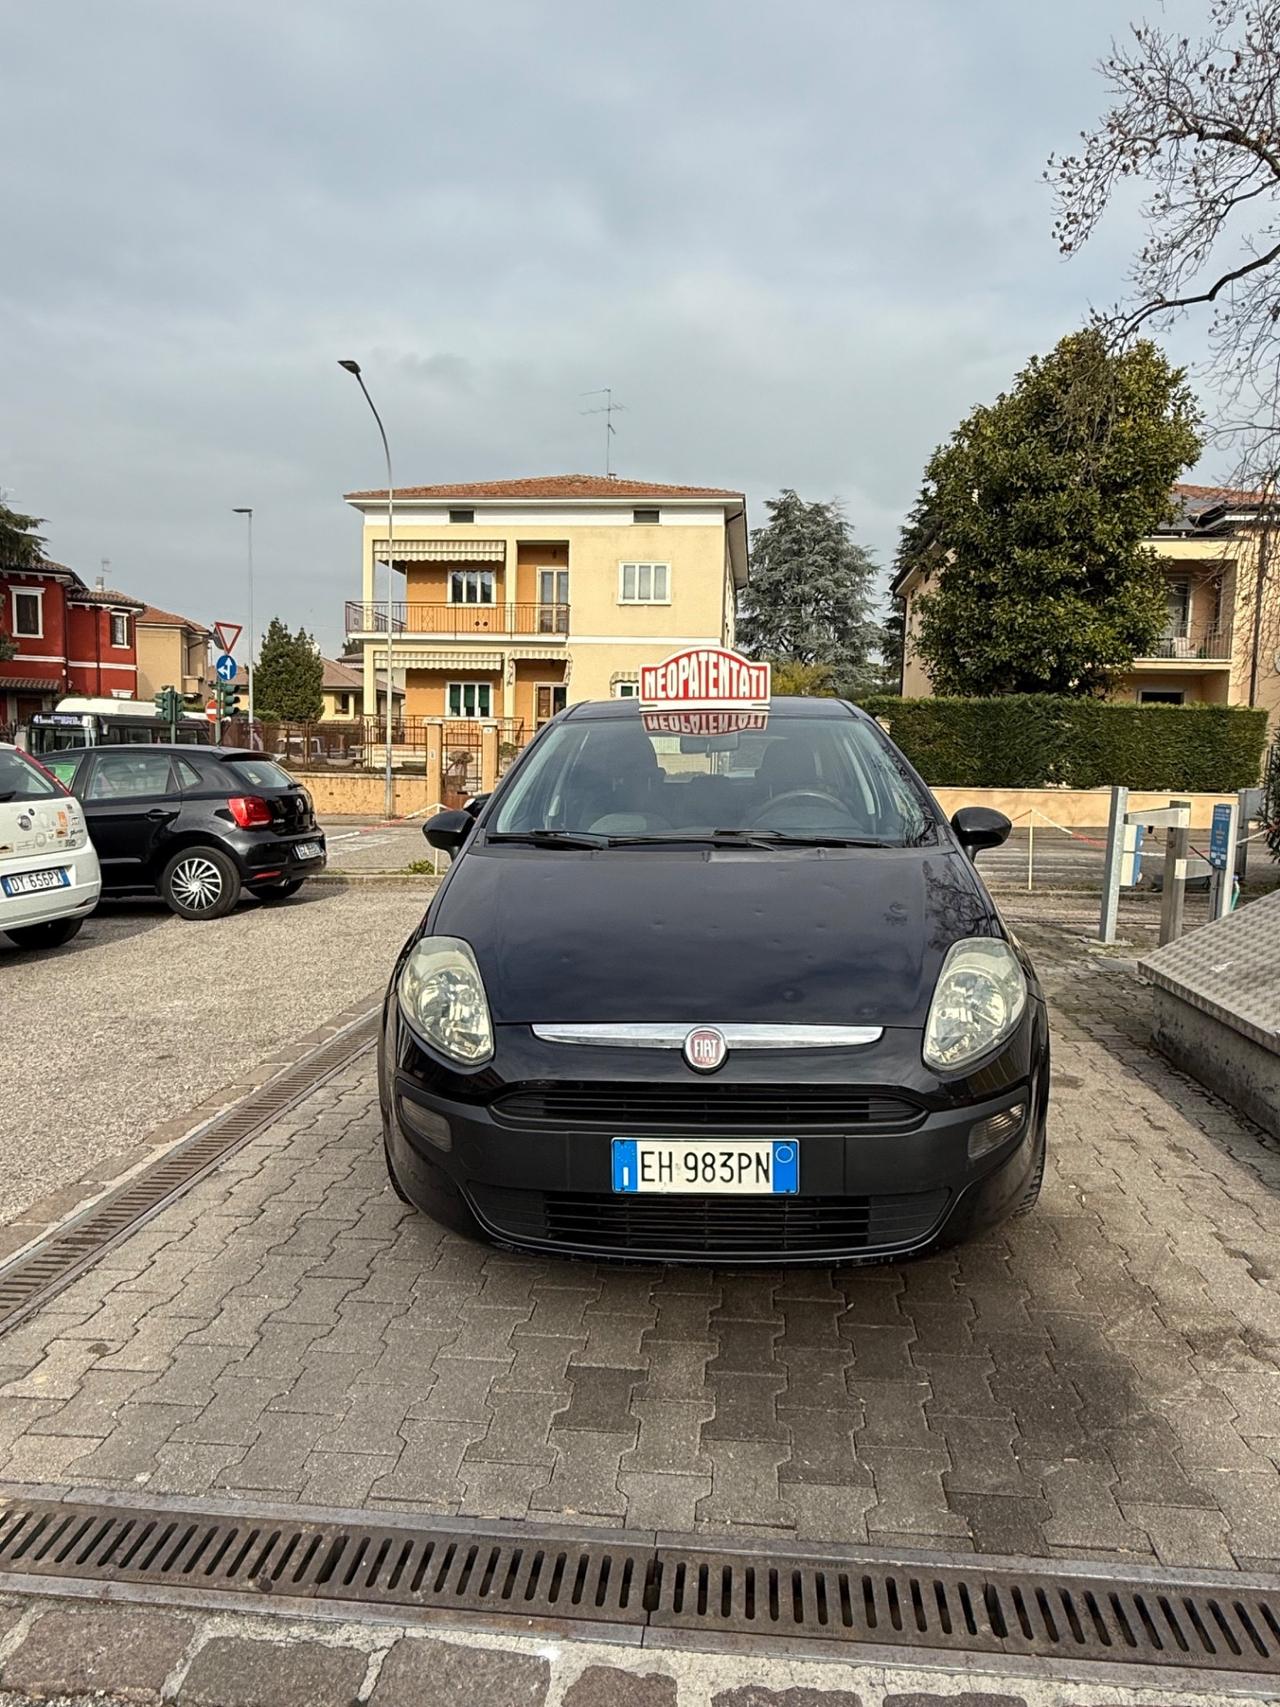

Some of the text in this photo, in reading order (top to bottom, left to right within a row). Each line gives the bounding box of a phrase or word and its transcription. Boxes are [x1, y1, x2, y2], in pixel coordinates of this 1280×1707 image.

[644, 651, 766, 698] NEOPATENTATI
[10, 876, 25, 891] DY
[694, 1039, 718, 1057] FIAT
[641, 1151, 770, 1184] EH 983PN
